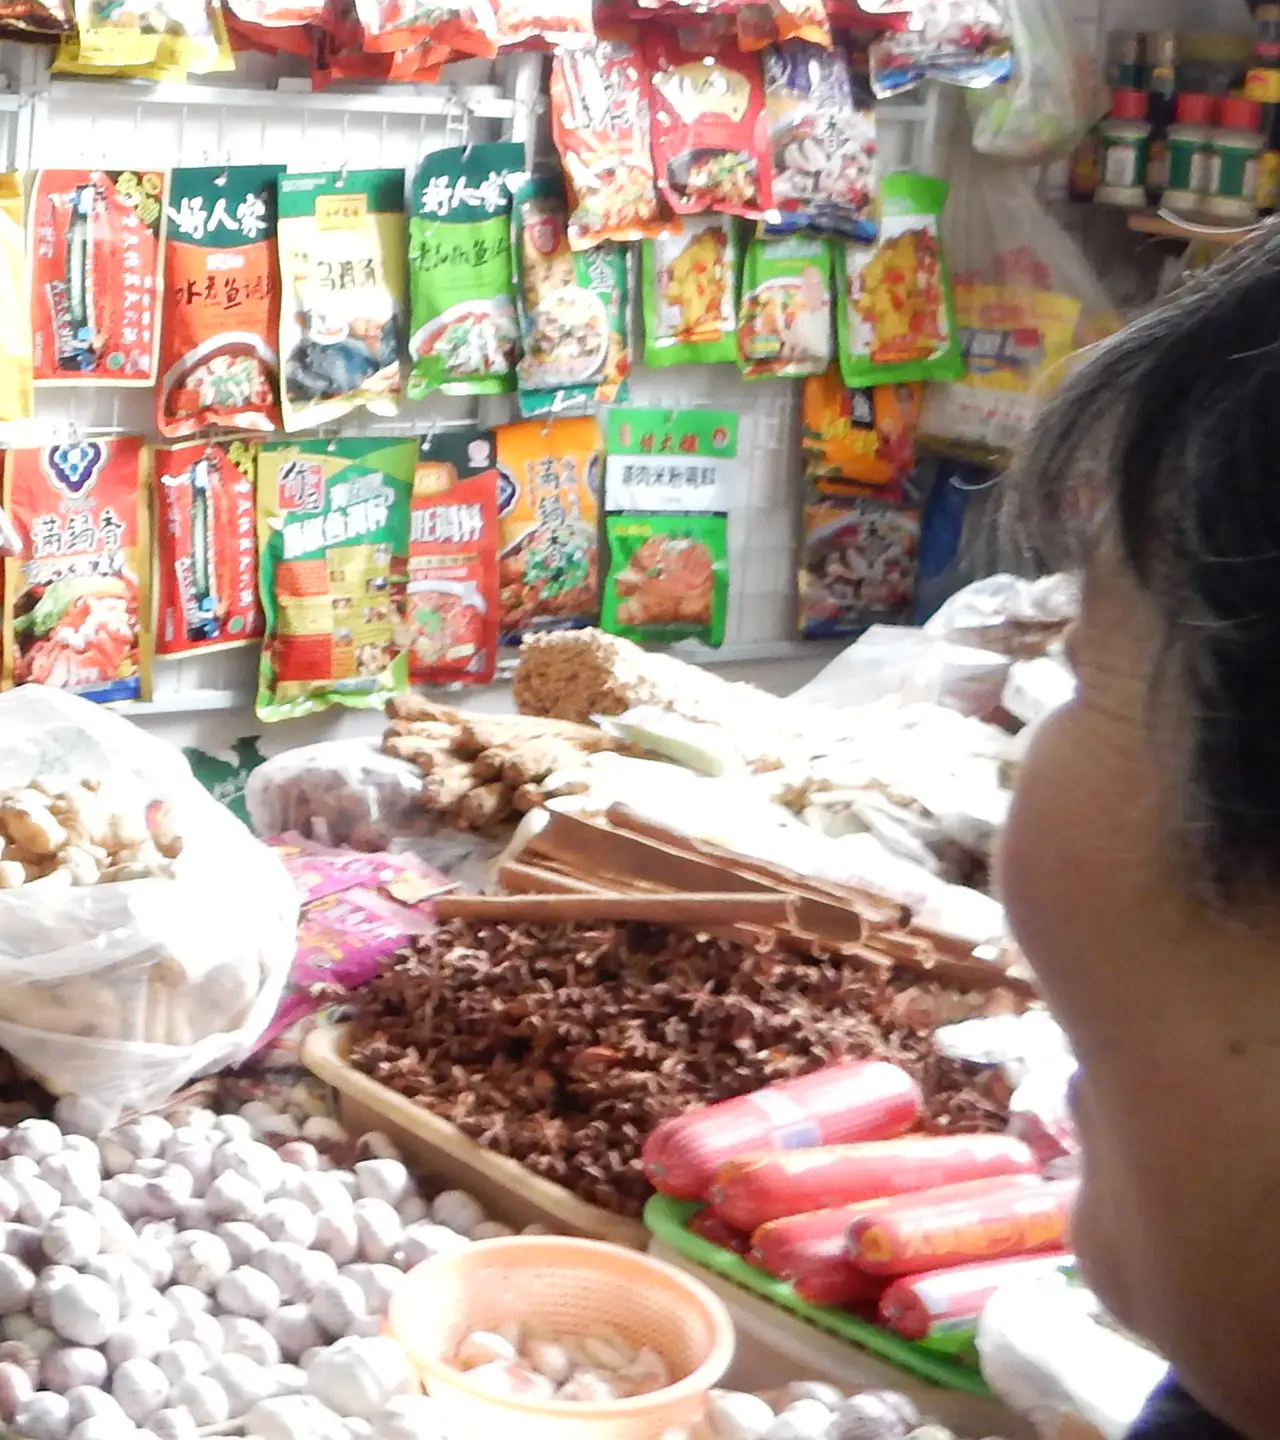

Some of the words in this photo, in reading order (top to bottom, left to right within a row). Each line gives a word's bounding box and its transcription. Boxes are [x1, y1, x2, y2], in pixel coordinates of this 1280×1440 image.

[165, 192, 267, 240] 好人家
[419, 170, 508, 217] 好人家
